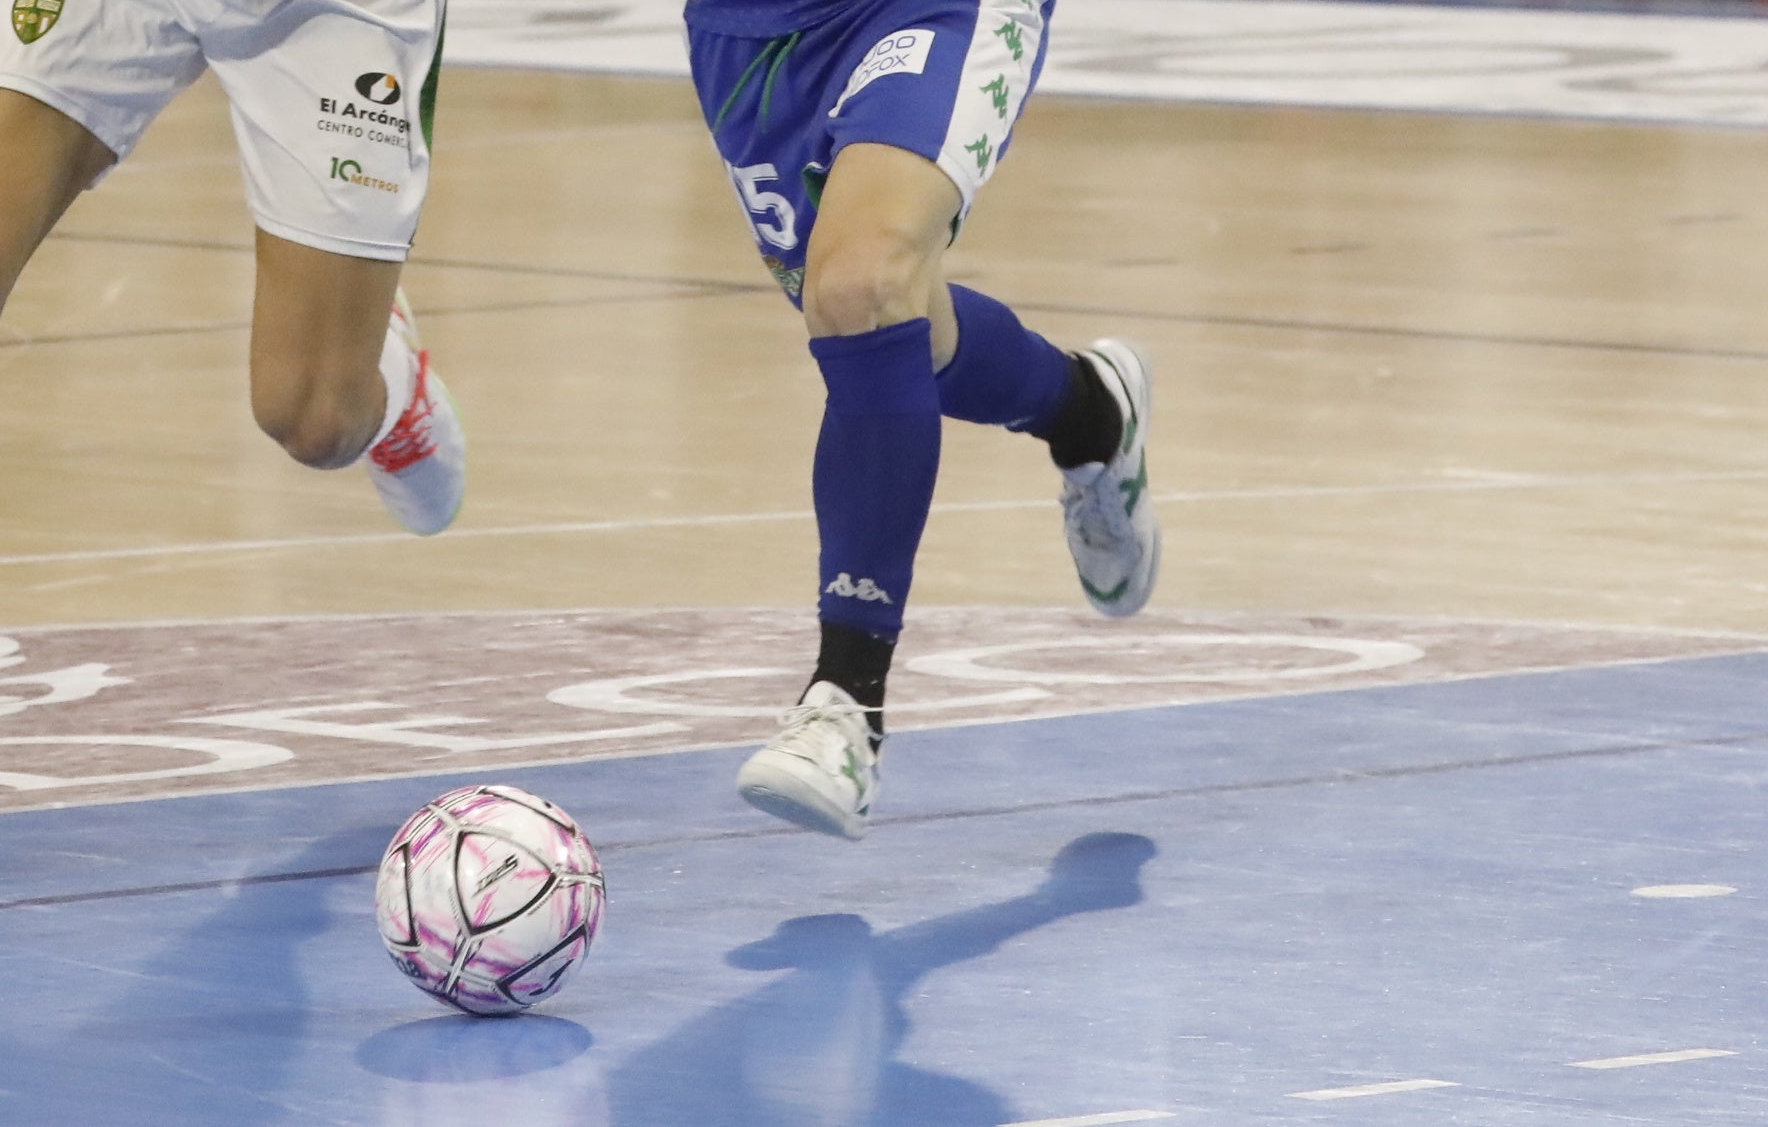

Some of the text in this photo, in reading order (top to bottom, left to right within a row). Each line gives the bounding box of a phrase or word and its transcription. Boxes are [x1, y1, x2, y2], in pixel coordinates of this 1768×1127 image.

[320, 97, 337, 114] El
[317, 119, 364, 138] CENTRO
[350, 173, 400, 194] METROS
